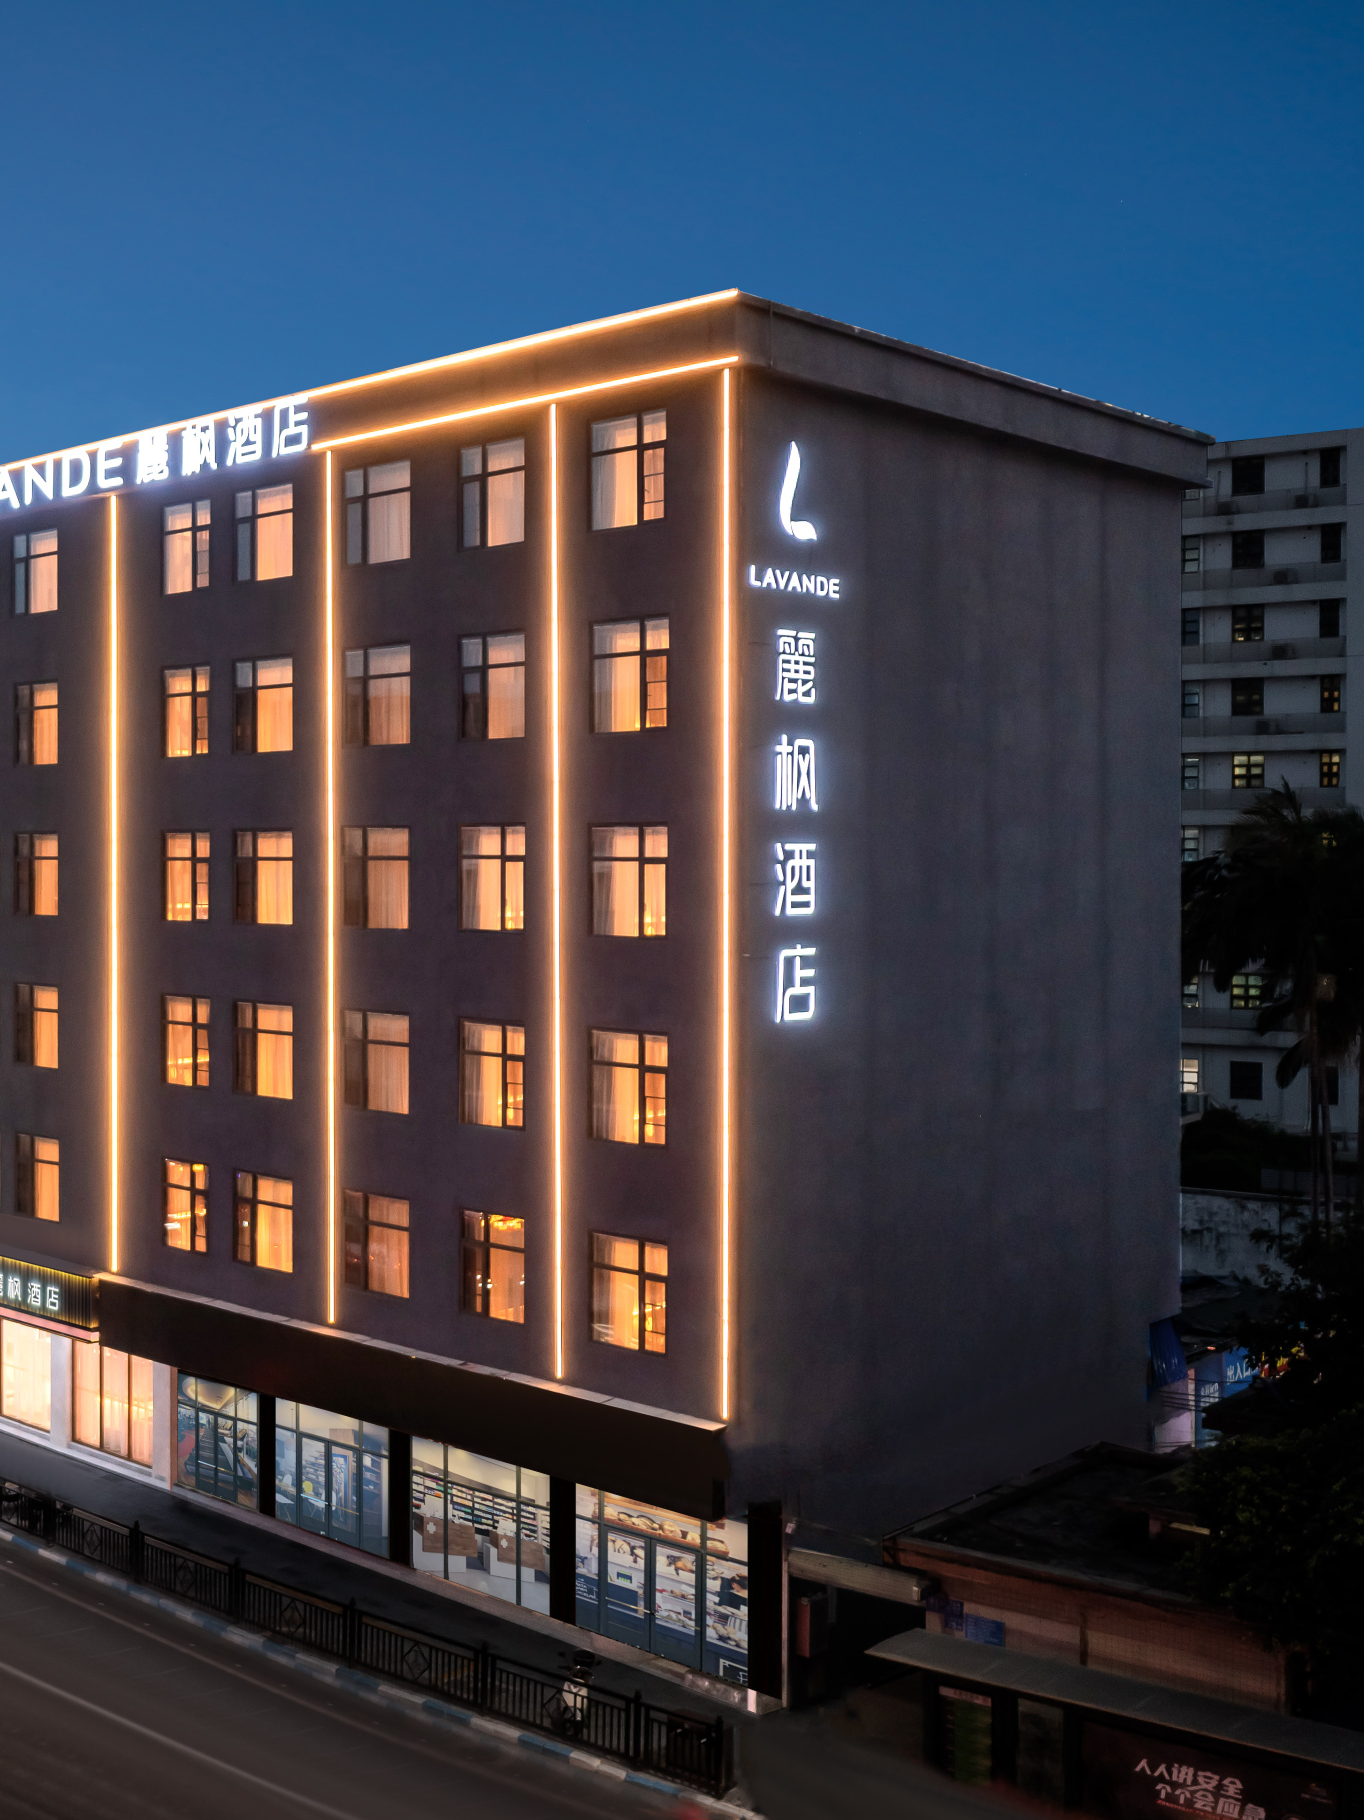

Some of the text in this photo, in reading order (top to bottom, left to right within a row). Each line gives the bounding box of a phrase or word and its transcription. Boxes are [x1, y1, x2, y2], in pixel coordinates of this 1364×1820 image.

[748, 564, 841, 599] LAVANDE
[773, 628, 820, 1024] 麗枫酒店
[1134, 1758, 1244, 1799] 人人讲安全
[1155, 1783, 1266, 1820] 个个会应急
